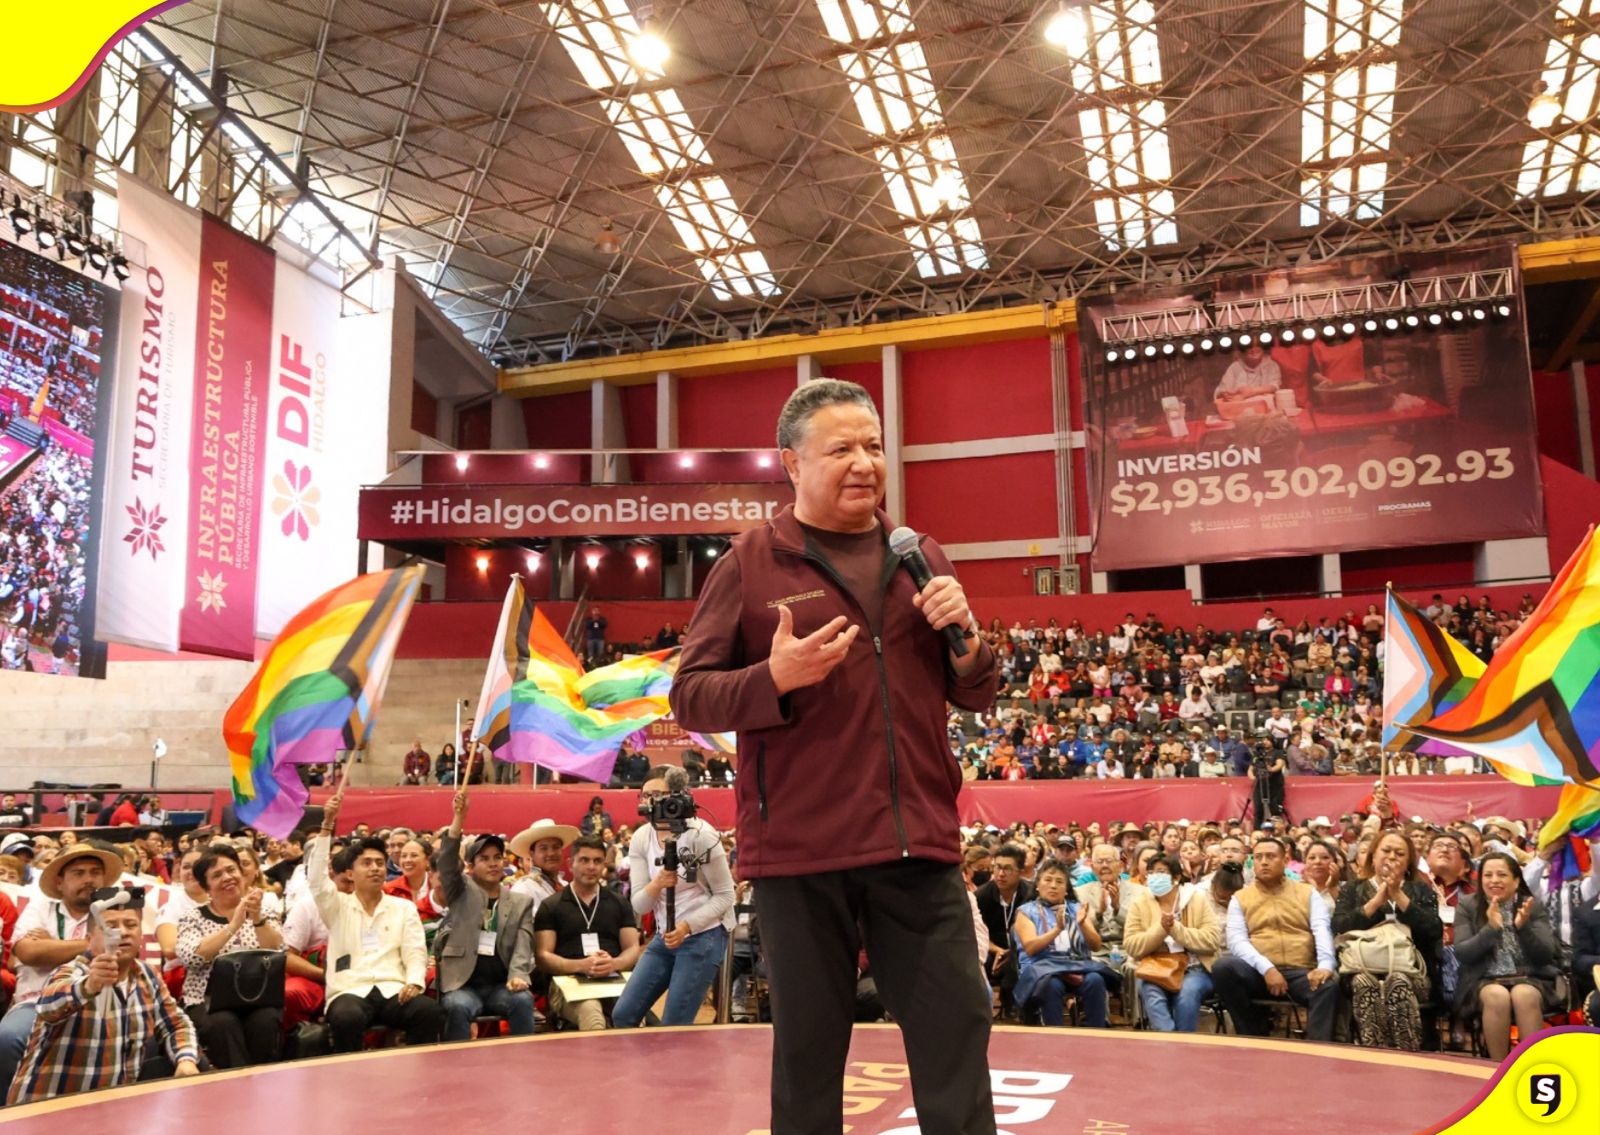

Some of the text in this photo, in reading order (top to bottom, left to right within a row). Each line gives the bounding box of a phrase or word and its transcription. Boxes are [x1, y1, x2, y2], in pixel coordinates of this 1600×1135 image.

[132, 266, 164, 481] TURISMO
[198, 259, 229, 560] INFRAESTRUCTURA
[277, 334, 311, 448] DIF
[313, 352, 326, 453] HIDALGO
[239, 407, 250, 495] INFRAESTRUCTURA
[248, 395, 258, 453] SOSTENIBLE
[1117, 444, 1261, 478] INVERSIÓN
[214, 430, 240, 566] PÚBLICA
[247, 456, 255, 494] URBANO
[390, 496, 777, 530] #HidalgoConBienestar
[1110, 447, 1515, 518] $2,936,302,092.93
[243, 496, 252, 561] DESARROLLO
